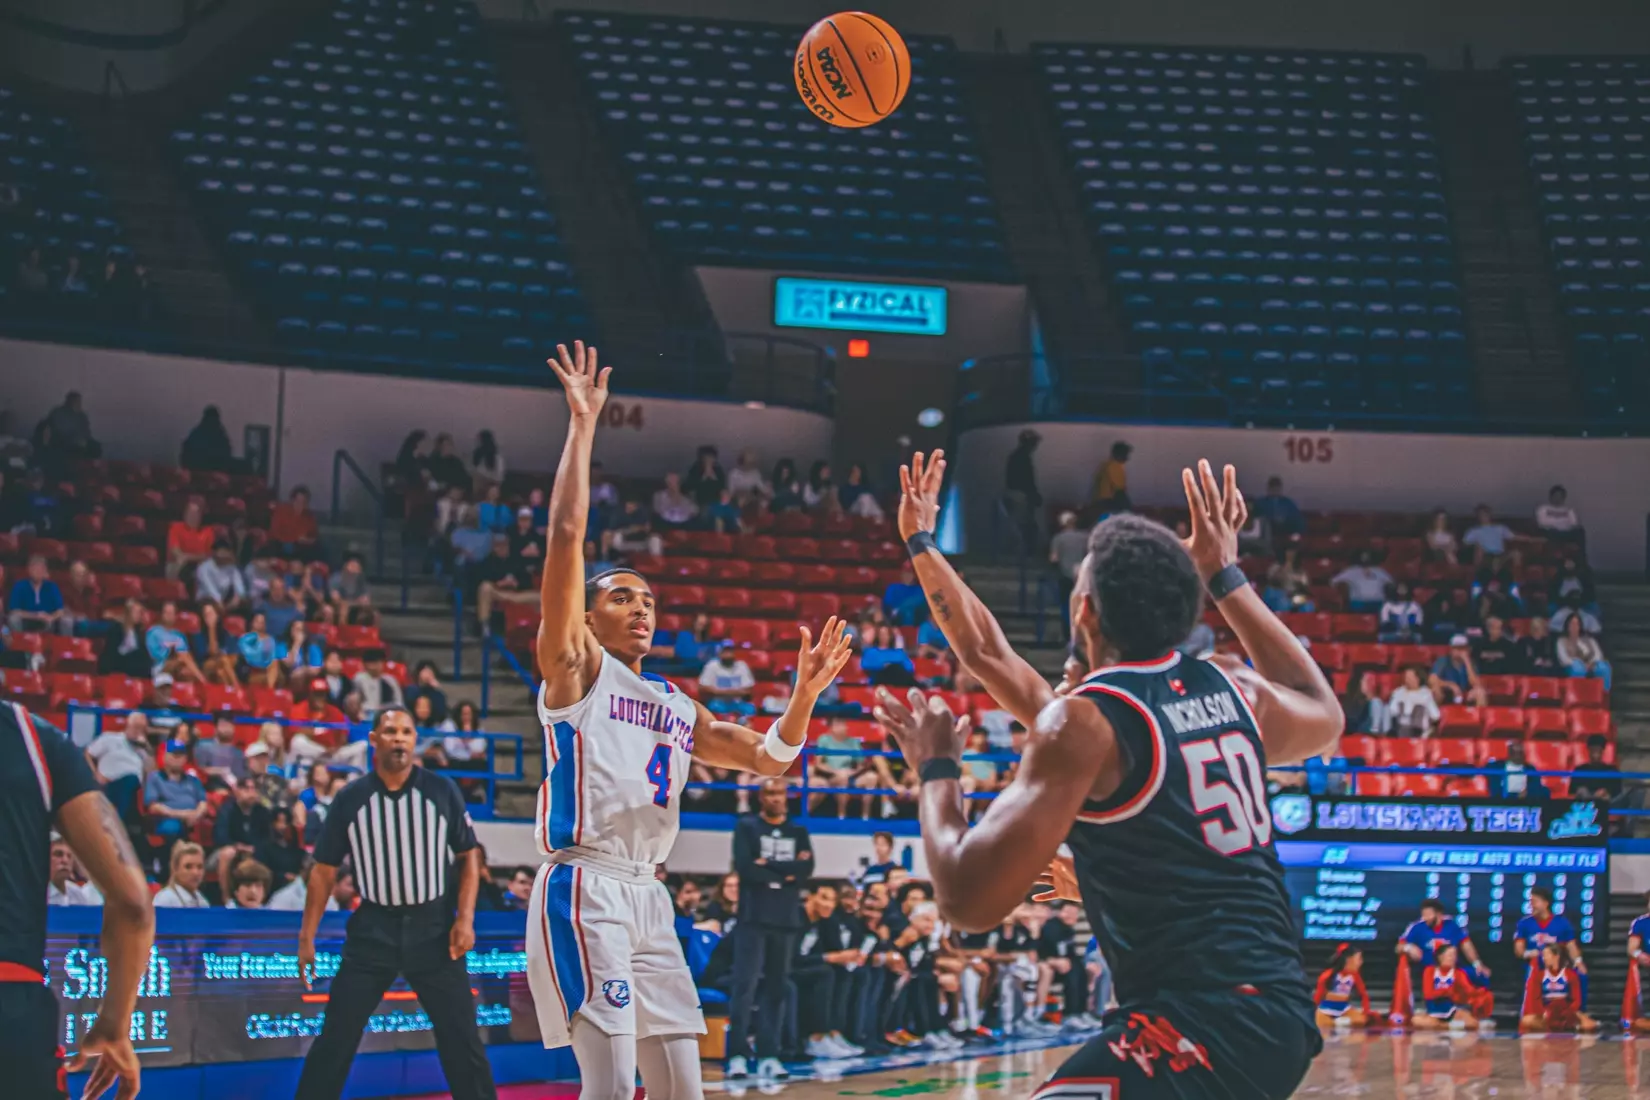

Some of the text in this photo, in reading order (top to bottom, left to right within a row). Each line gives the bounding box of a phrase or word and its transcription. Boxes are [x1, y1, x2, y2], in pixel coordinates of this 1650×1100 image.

[816, 46, 853, 100] NCAA
[1283, 436, 1334, 463] 105
[1161, 690, 1240, 734] NICHOLSON
[645, 742, 673, 809] 4
[1179, 730, 1273, 857] 50
[1317, 802, 1467, 832] LOUISIANA
[1467, 805, 1542, 833] TECH
[62, 944, 171, 999] Smh
